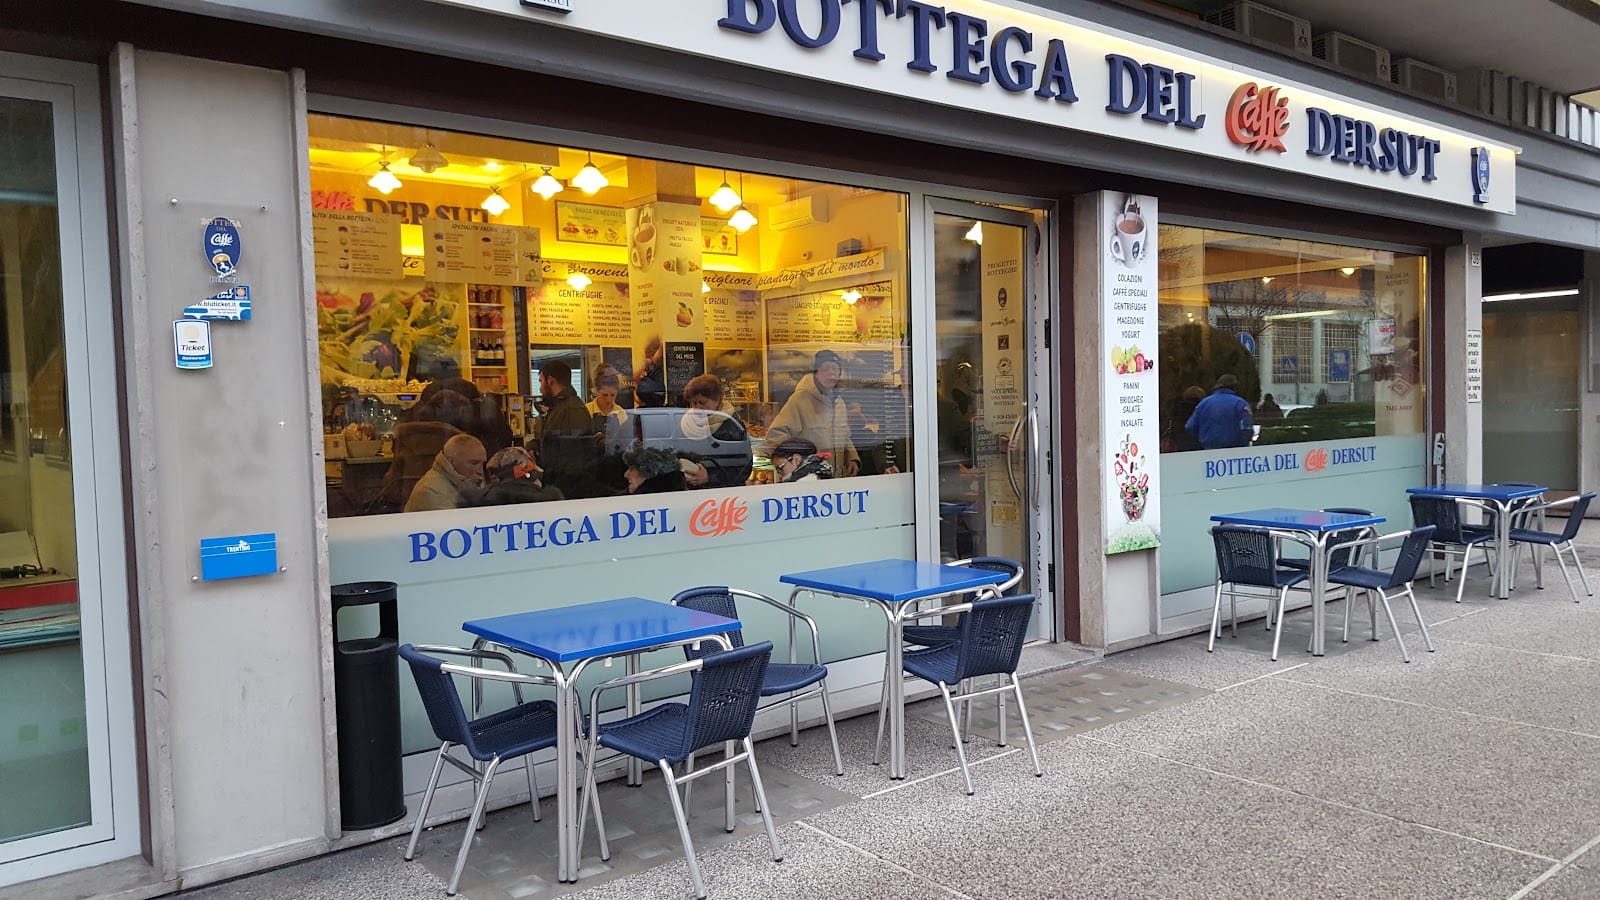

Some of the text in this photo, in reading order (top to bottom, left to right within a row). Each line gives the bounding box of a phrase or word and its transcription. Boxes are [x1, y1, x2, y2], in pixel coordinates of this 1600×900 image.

[1104, 53, 1206, 130] DEL
[1306, 107, 1441, 181] DERSUT
[1117, 273, 1143, 283] COLAZIONI
[558, 289, 603, 300] CENTRIFUGHE
[1127, 288, 1148, 297] SPECIALI
[1113, 302, 1147, 311] CENTRIFUGHE
[1117, 316, 1145, 325] MACEDONIE
[1121, 330, 1141, 339] YOGURT
[1123, 382, 1140, 390] PANINI
[1122, 404, 1142, 414] SALATE
[1120, 418, 1144, 428] INSALATE
[1205, 456, 1271, 478] BOTTEGA
[1274, 453, 1299, 470] DEL
[1332, 446, 1377, 465] DERSUT
[408, 515, 600, 564] BOTTEGA
[609, 508, 676, 540] DEL
[761, 490, 869, 523] DERSUT
